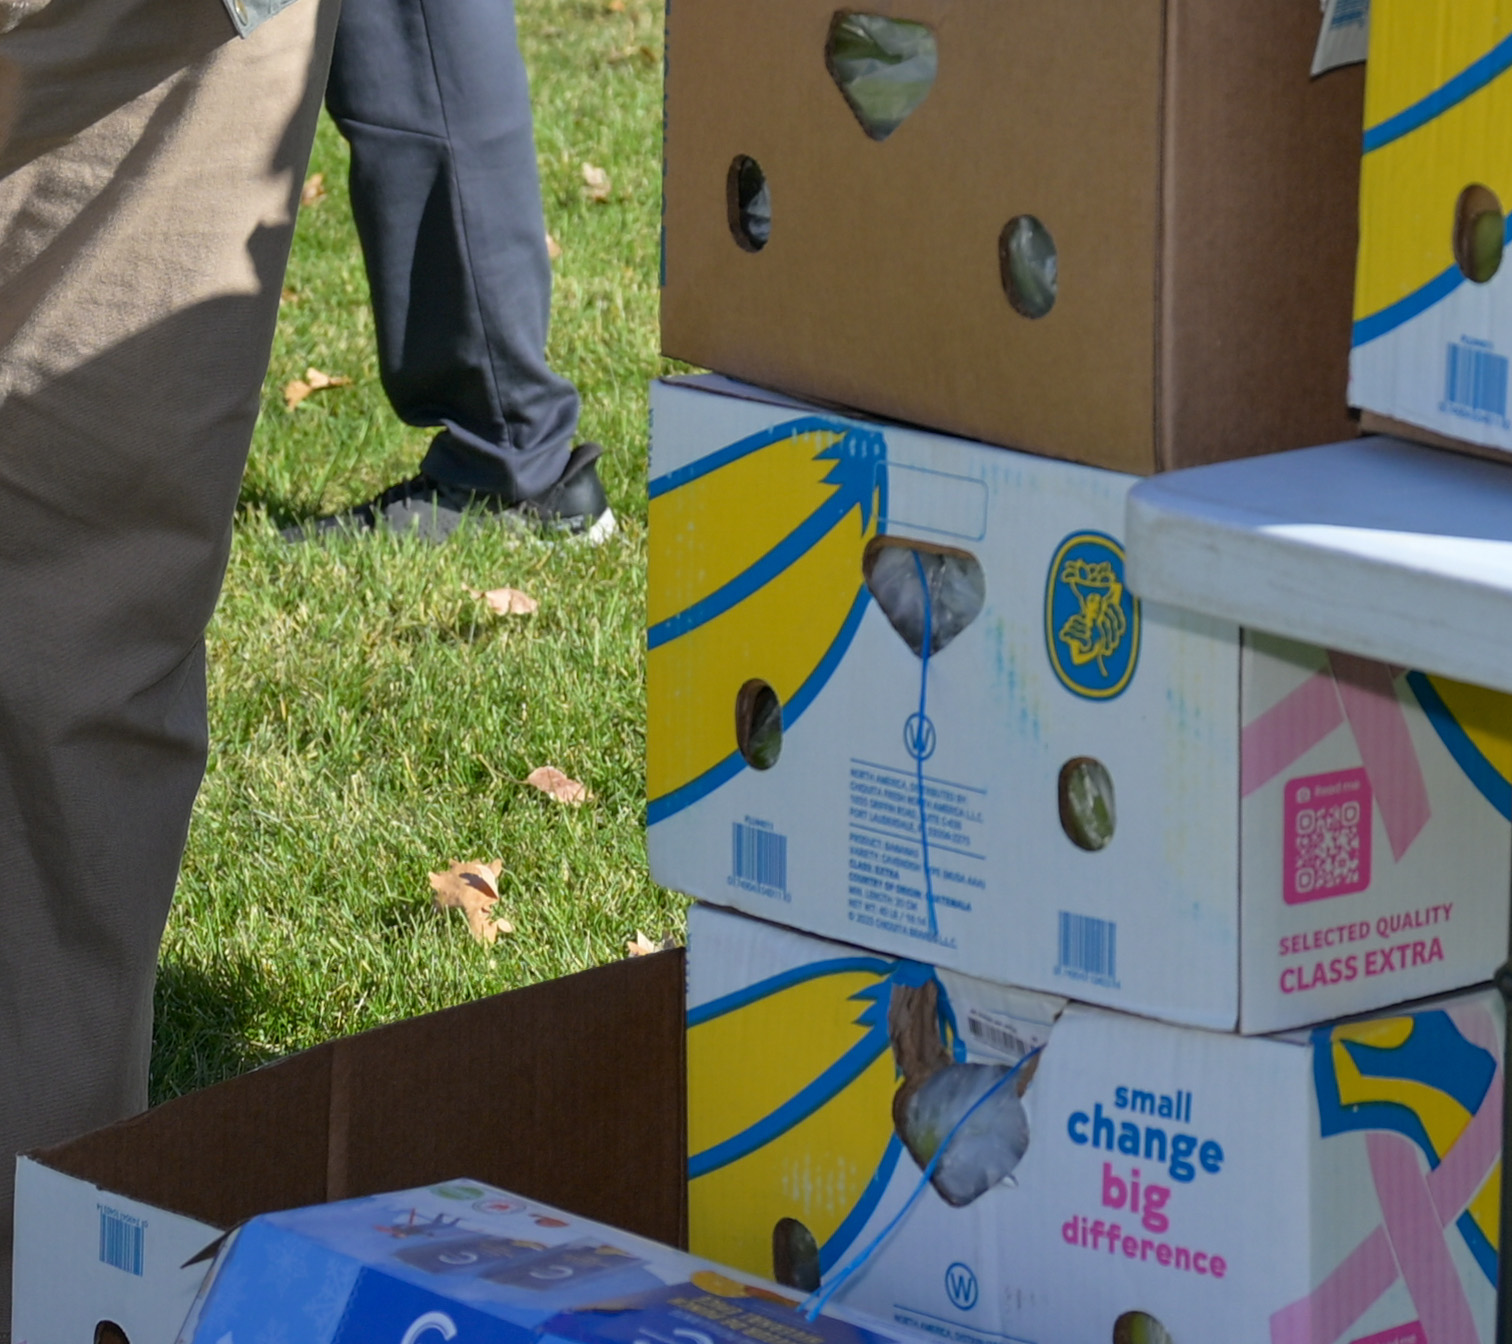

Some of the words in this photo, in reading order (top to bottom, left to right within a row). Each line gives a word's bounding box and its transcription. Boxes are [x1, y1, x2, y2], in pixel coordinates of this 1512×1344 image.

[1279, 921, 1370, 957] SELECTED
[1376, 902, 1453, 938] QUALITY
[1279, 954, 1358, 994] CLASS
[1365, 937, 1445, 977] EXTRA
[1115, 1085, 1192, 1123] small
[1067, 1102, 1225, 1184] change
[1102, 1161, 1171, 1234] big
[1061, 1215, 1228, 1279] difference
